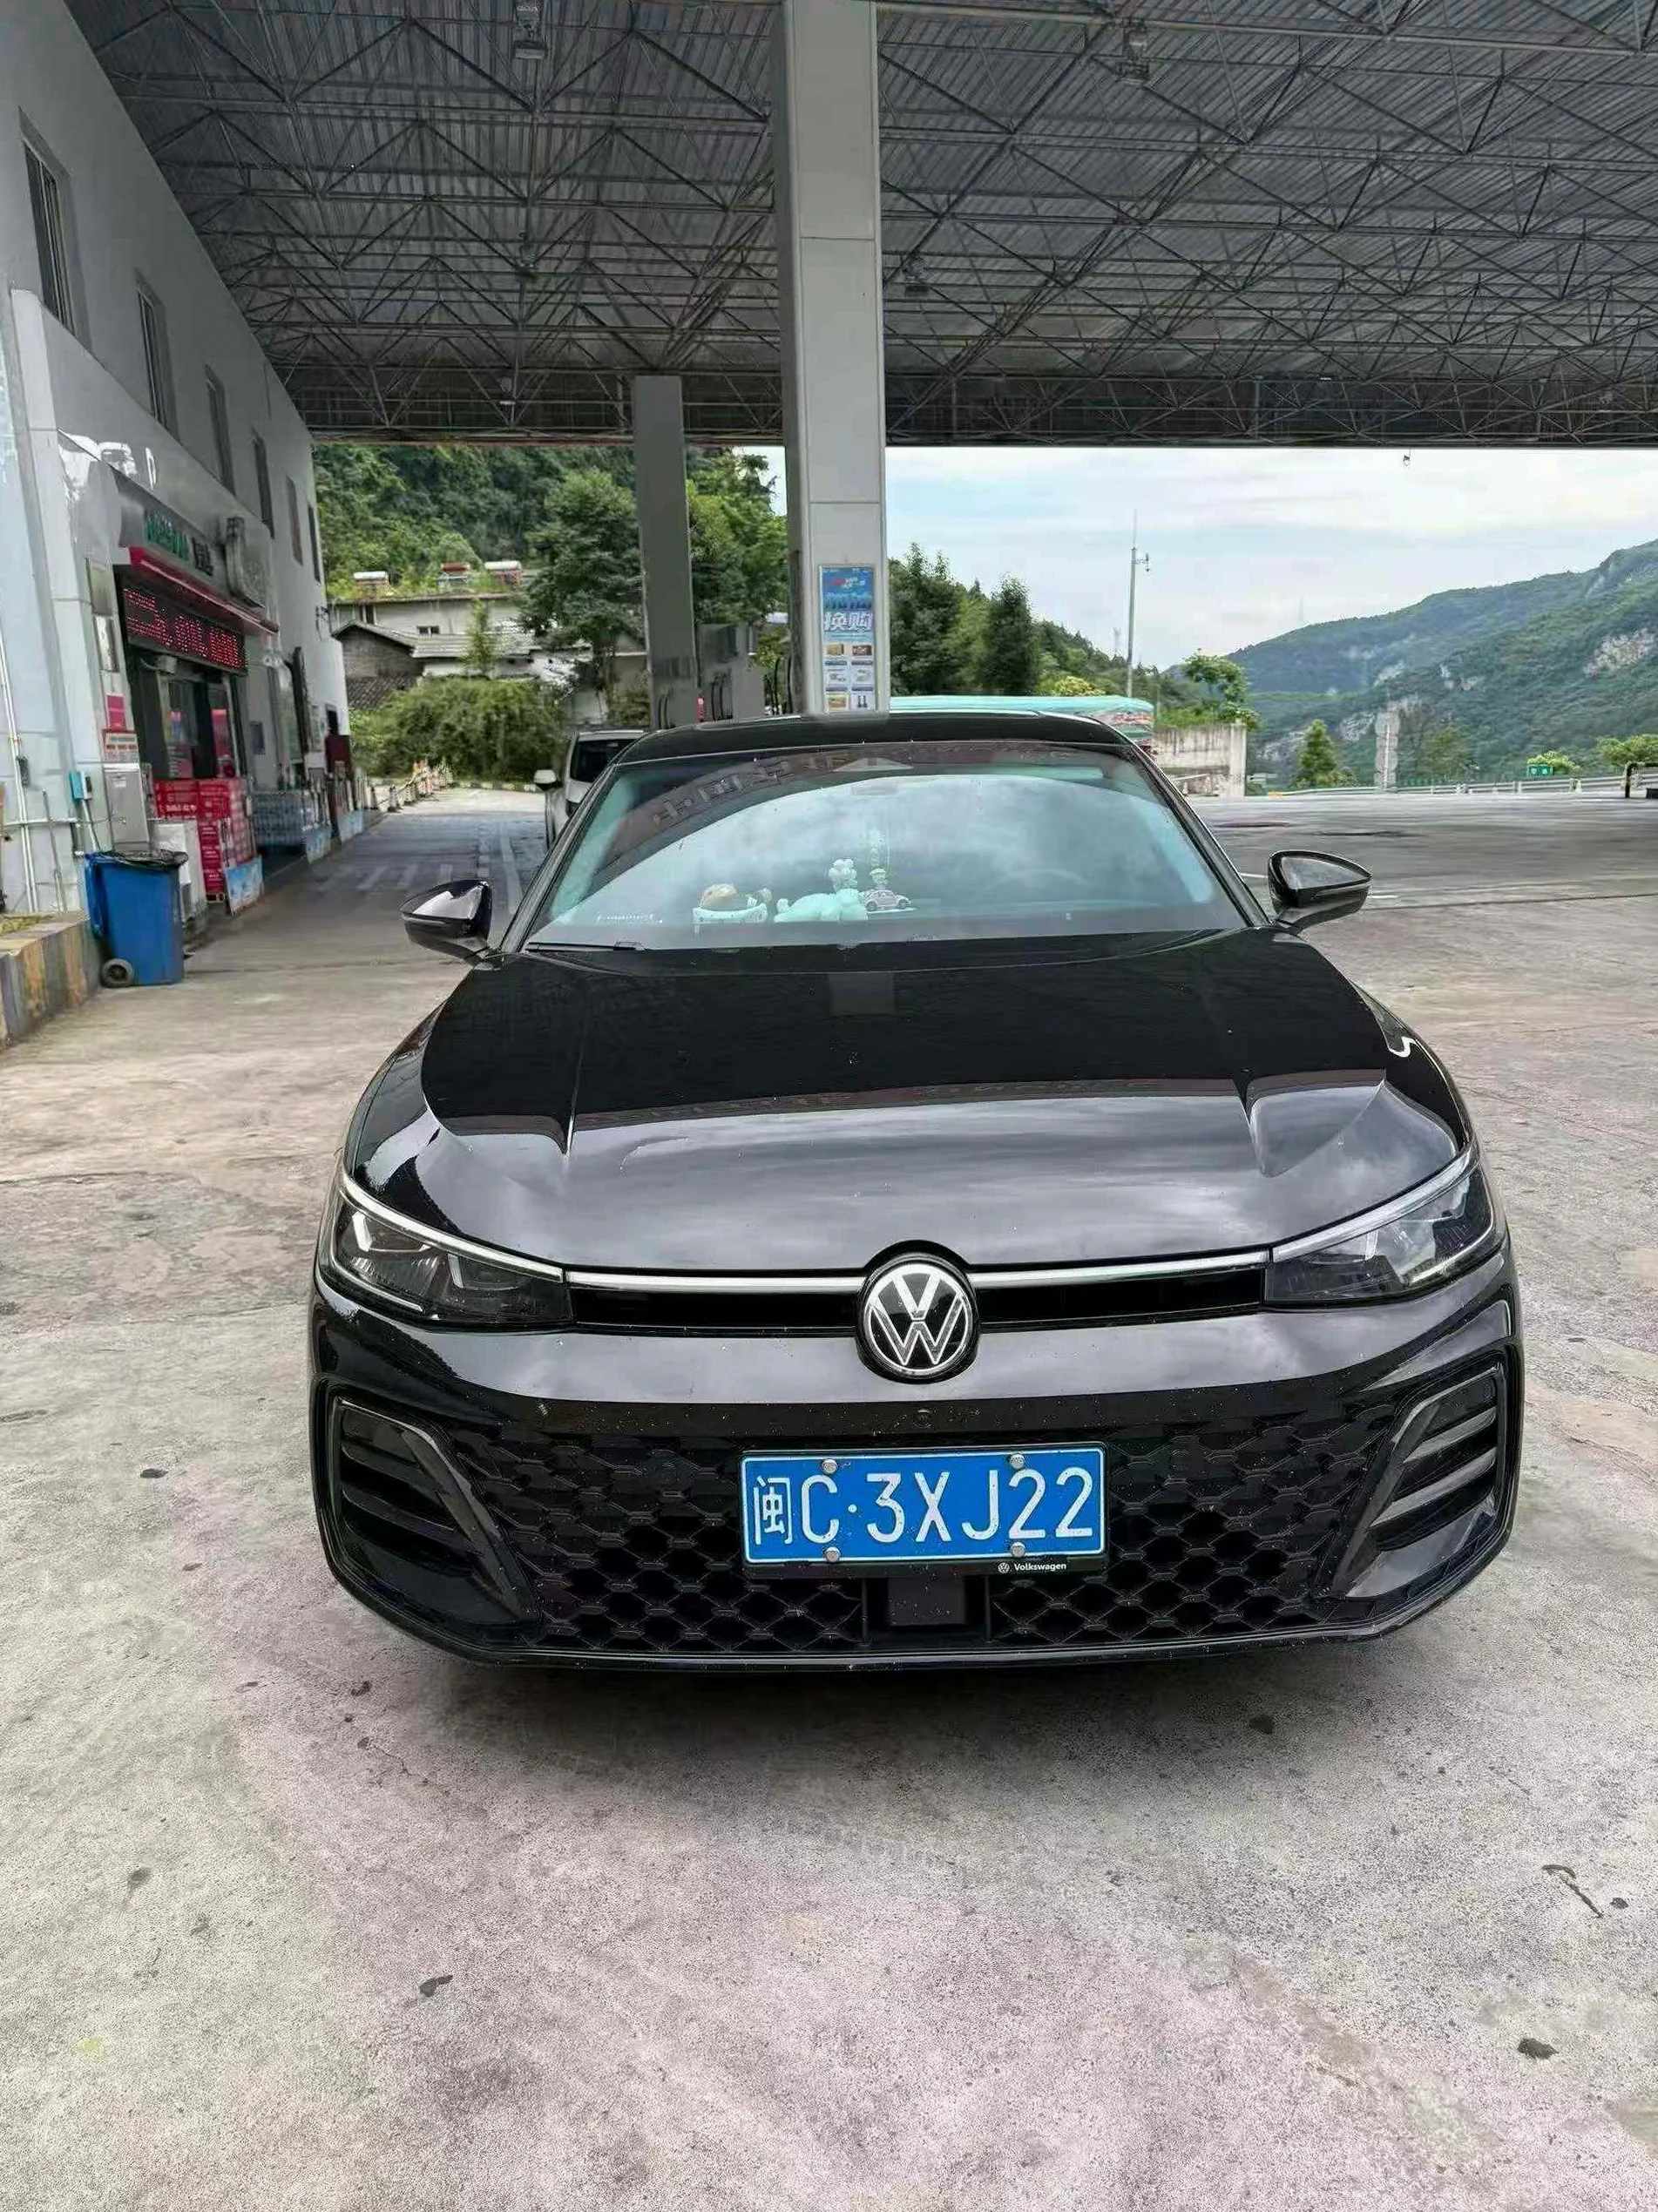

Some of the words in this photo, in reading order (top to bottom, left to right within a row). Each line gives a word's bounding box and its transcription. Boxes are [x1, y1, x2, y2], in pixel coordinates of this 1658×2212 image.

[824, 612, 873, 631] 换购
[754, 1466, 1094, 1546] 闽C·3XJ22
[1013, 1562, 1066, 1572] Volkswagen
